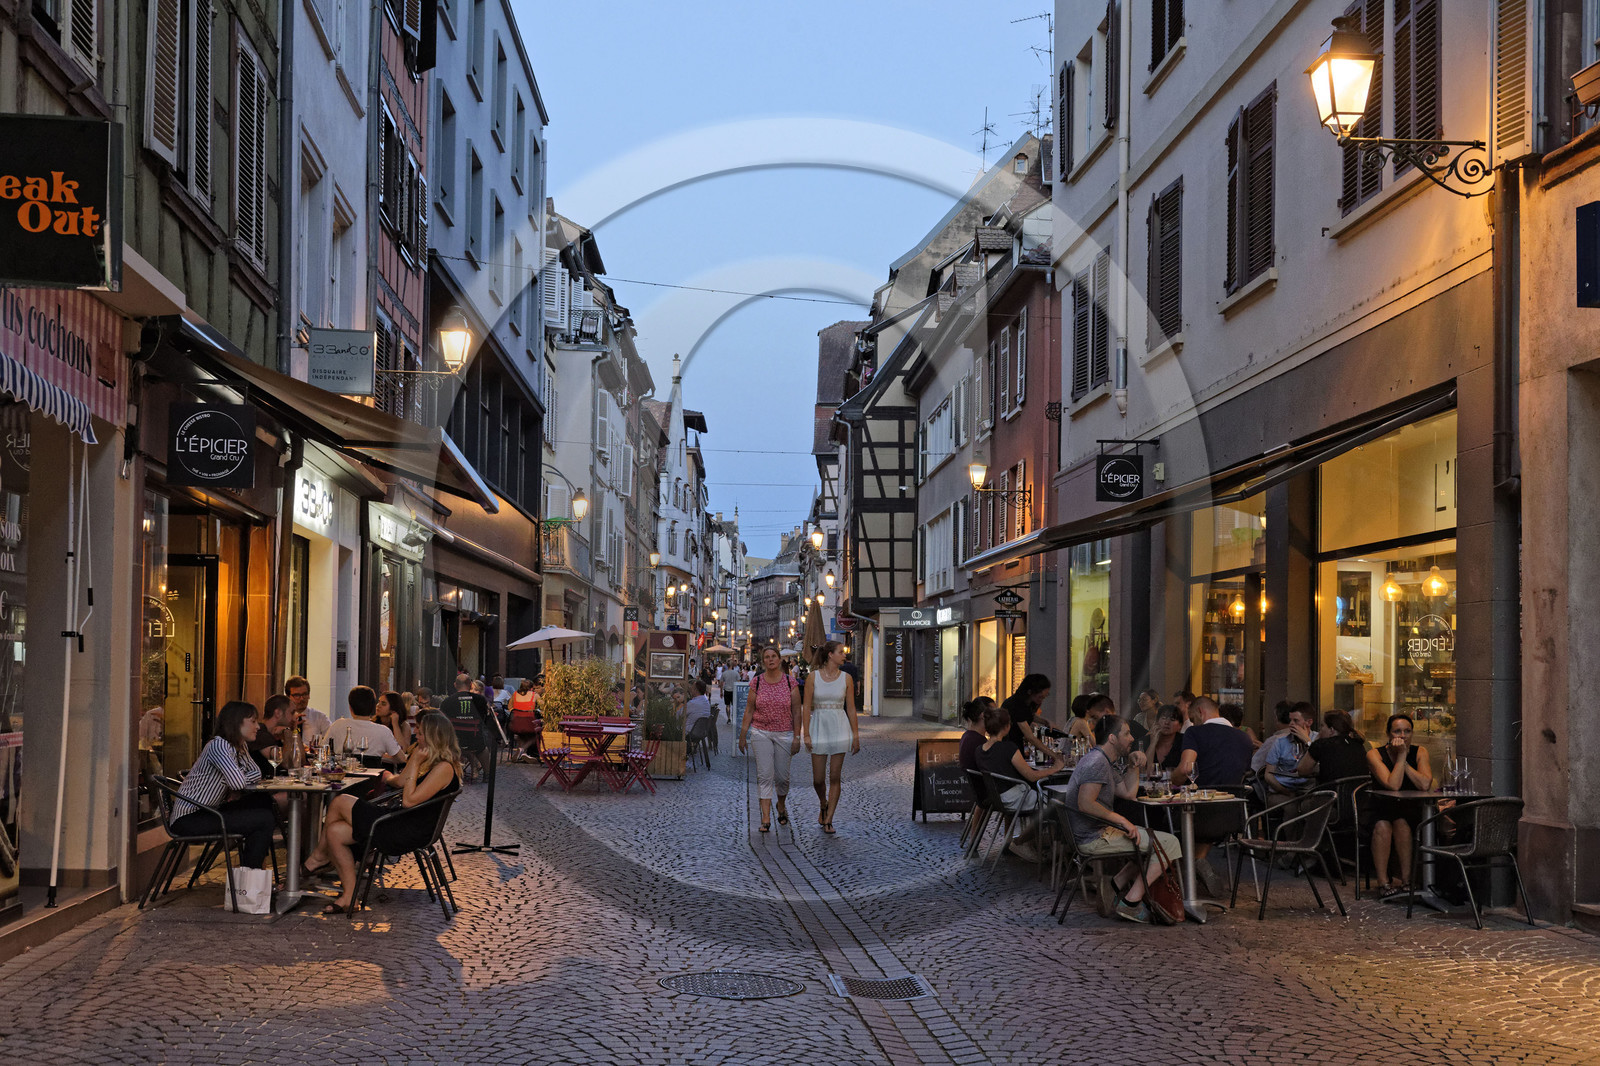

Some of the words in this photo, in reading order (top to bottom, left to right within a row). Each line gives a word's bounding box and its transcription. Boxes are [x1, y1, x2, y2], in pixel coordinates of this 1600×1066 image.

[0, 170, 80, 204] eak
[17, 200, 100, 237] Out
[28, 304, 92, 377] cochons
[176, 434, 248, 454] L'ÉPICIER
[1100, 472, 1140, 483] L'ÉPICIER
